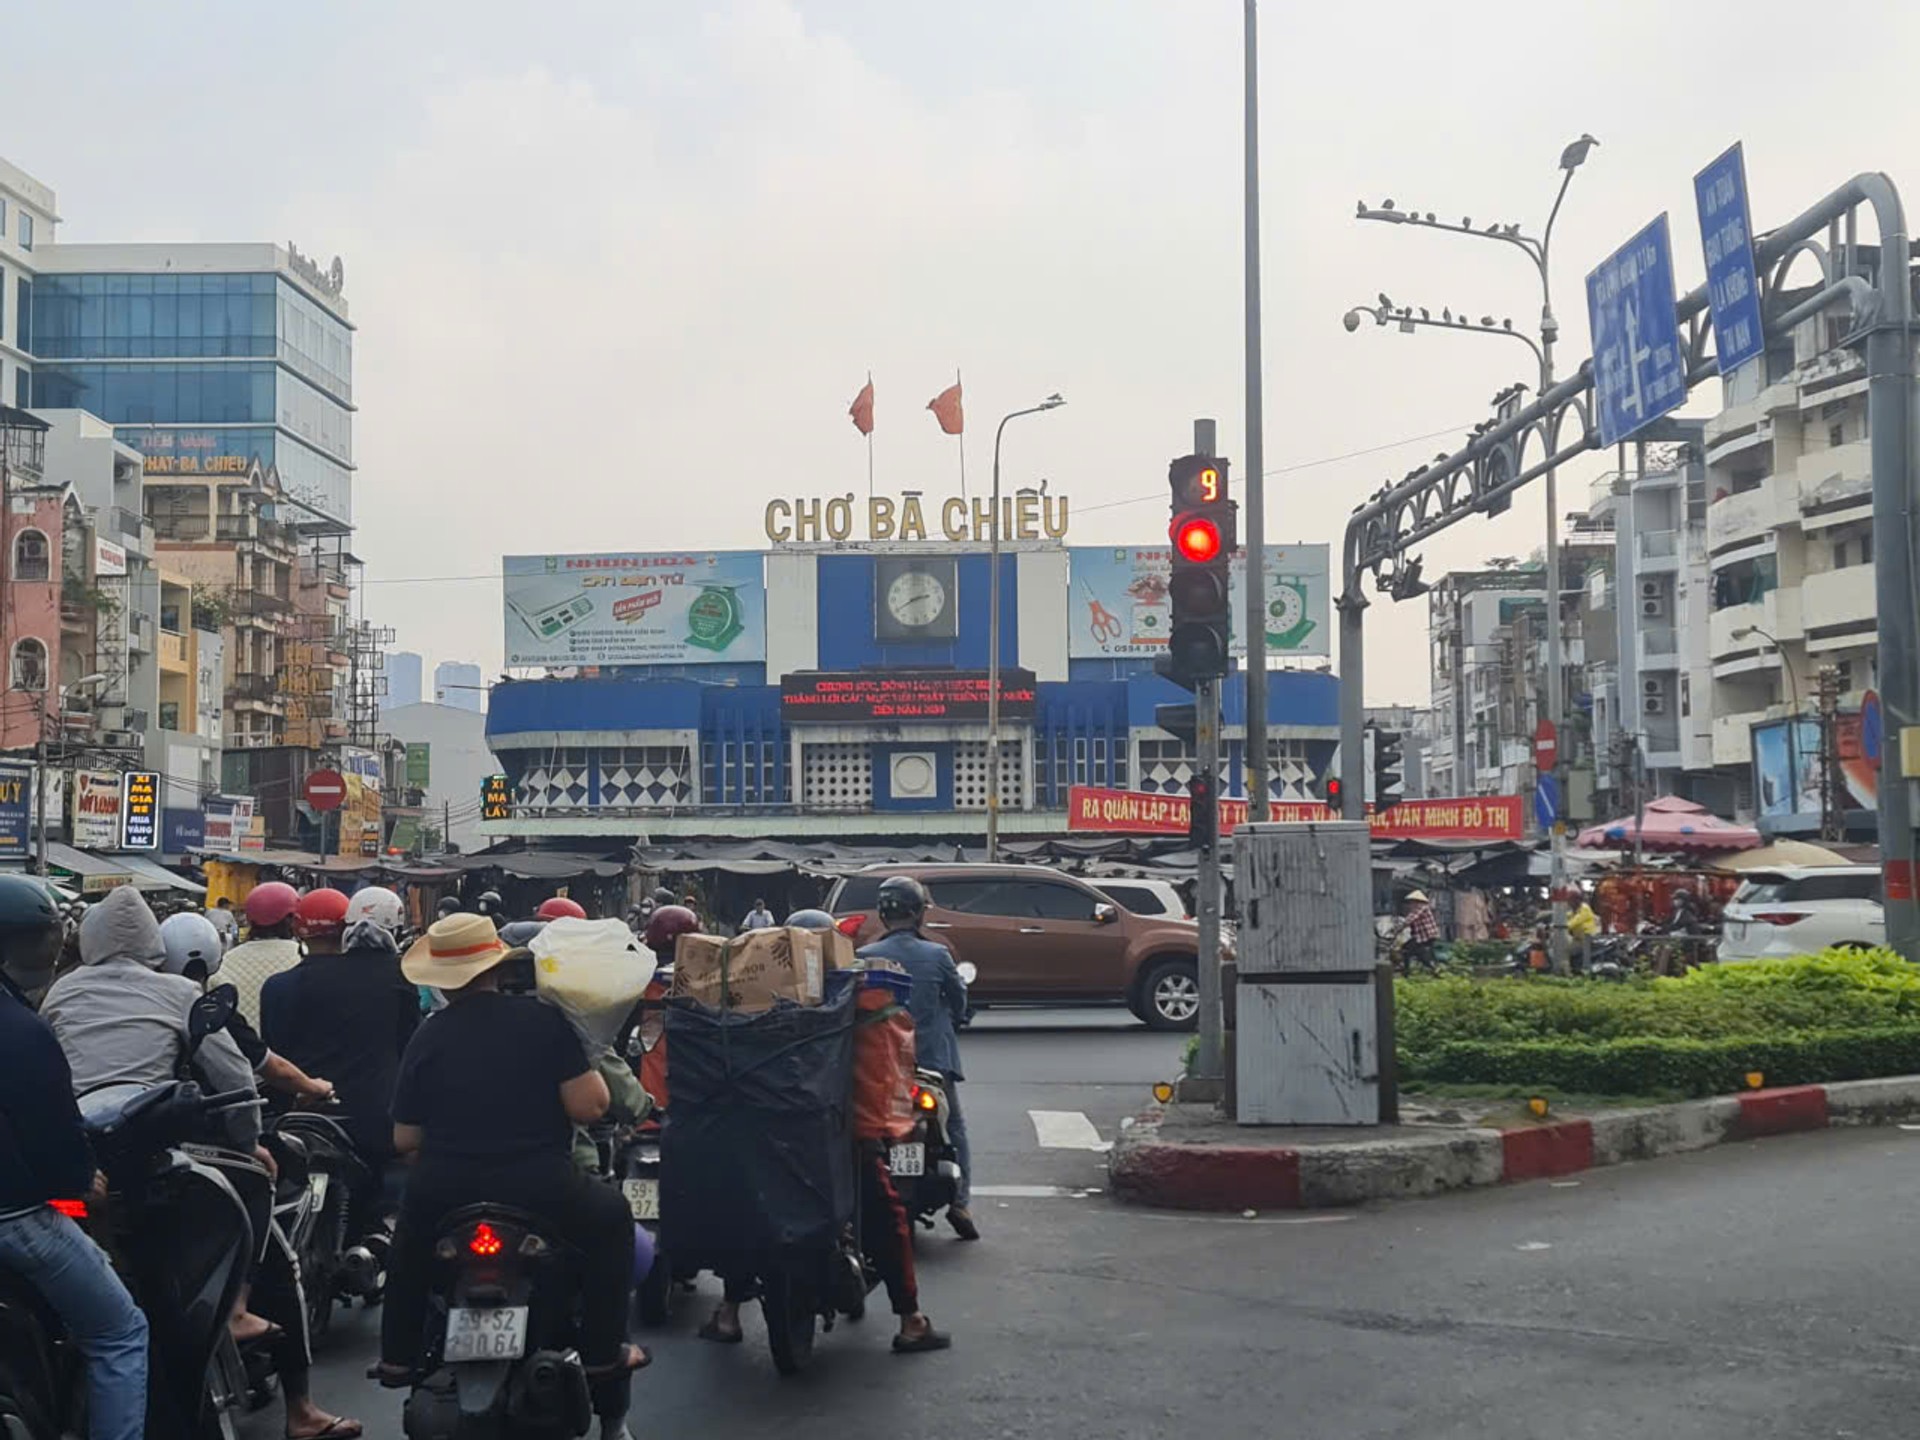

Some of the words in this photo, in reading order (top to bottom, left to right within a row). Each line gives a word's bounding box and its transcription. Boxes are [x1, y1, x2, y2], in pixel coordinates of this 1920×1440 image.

[1201, 468, 1217, 501] 9
[764, 493, 854, 541] CHỢ
[1082, 798, 1099, 818] RA
[1103, 795, 1138, 822] QUÂN
[1142, 797, 1166, 825] LẬP
[1425, 807, 1458, 828] MINH
[1463, 803, 1482, 828] ĐÔ
[1486, 806, 1509, 833] THỊ
